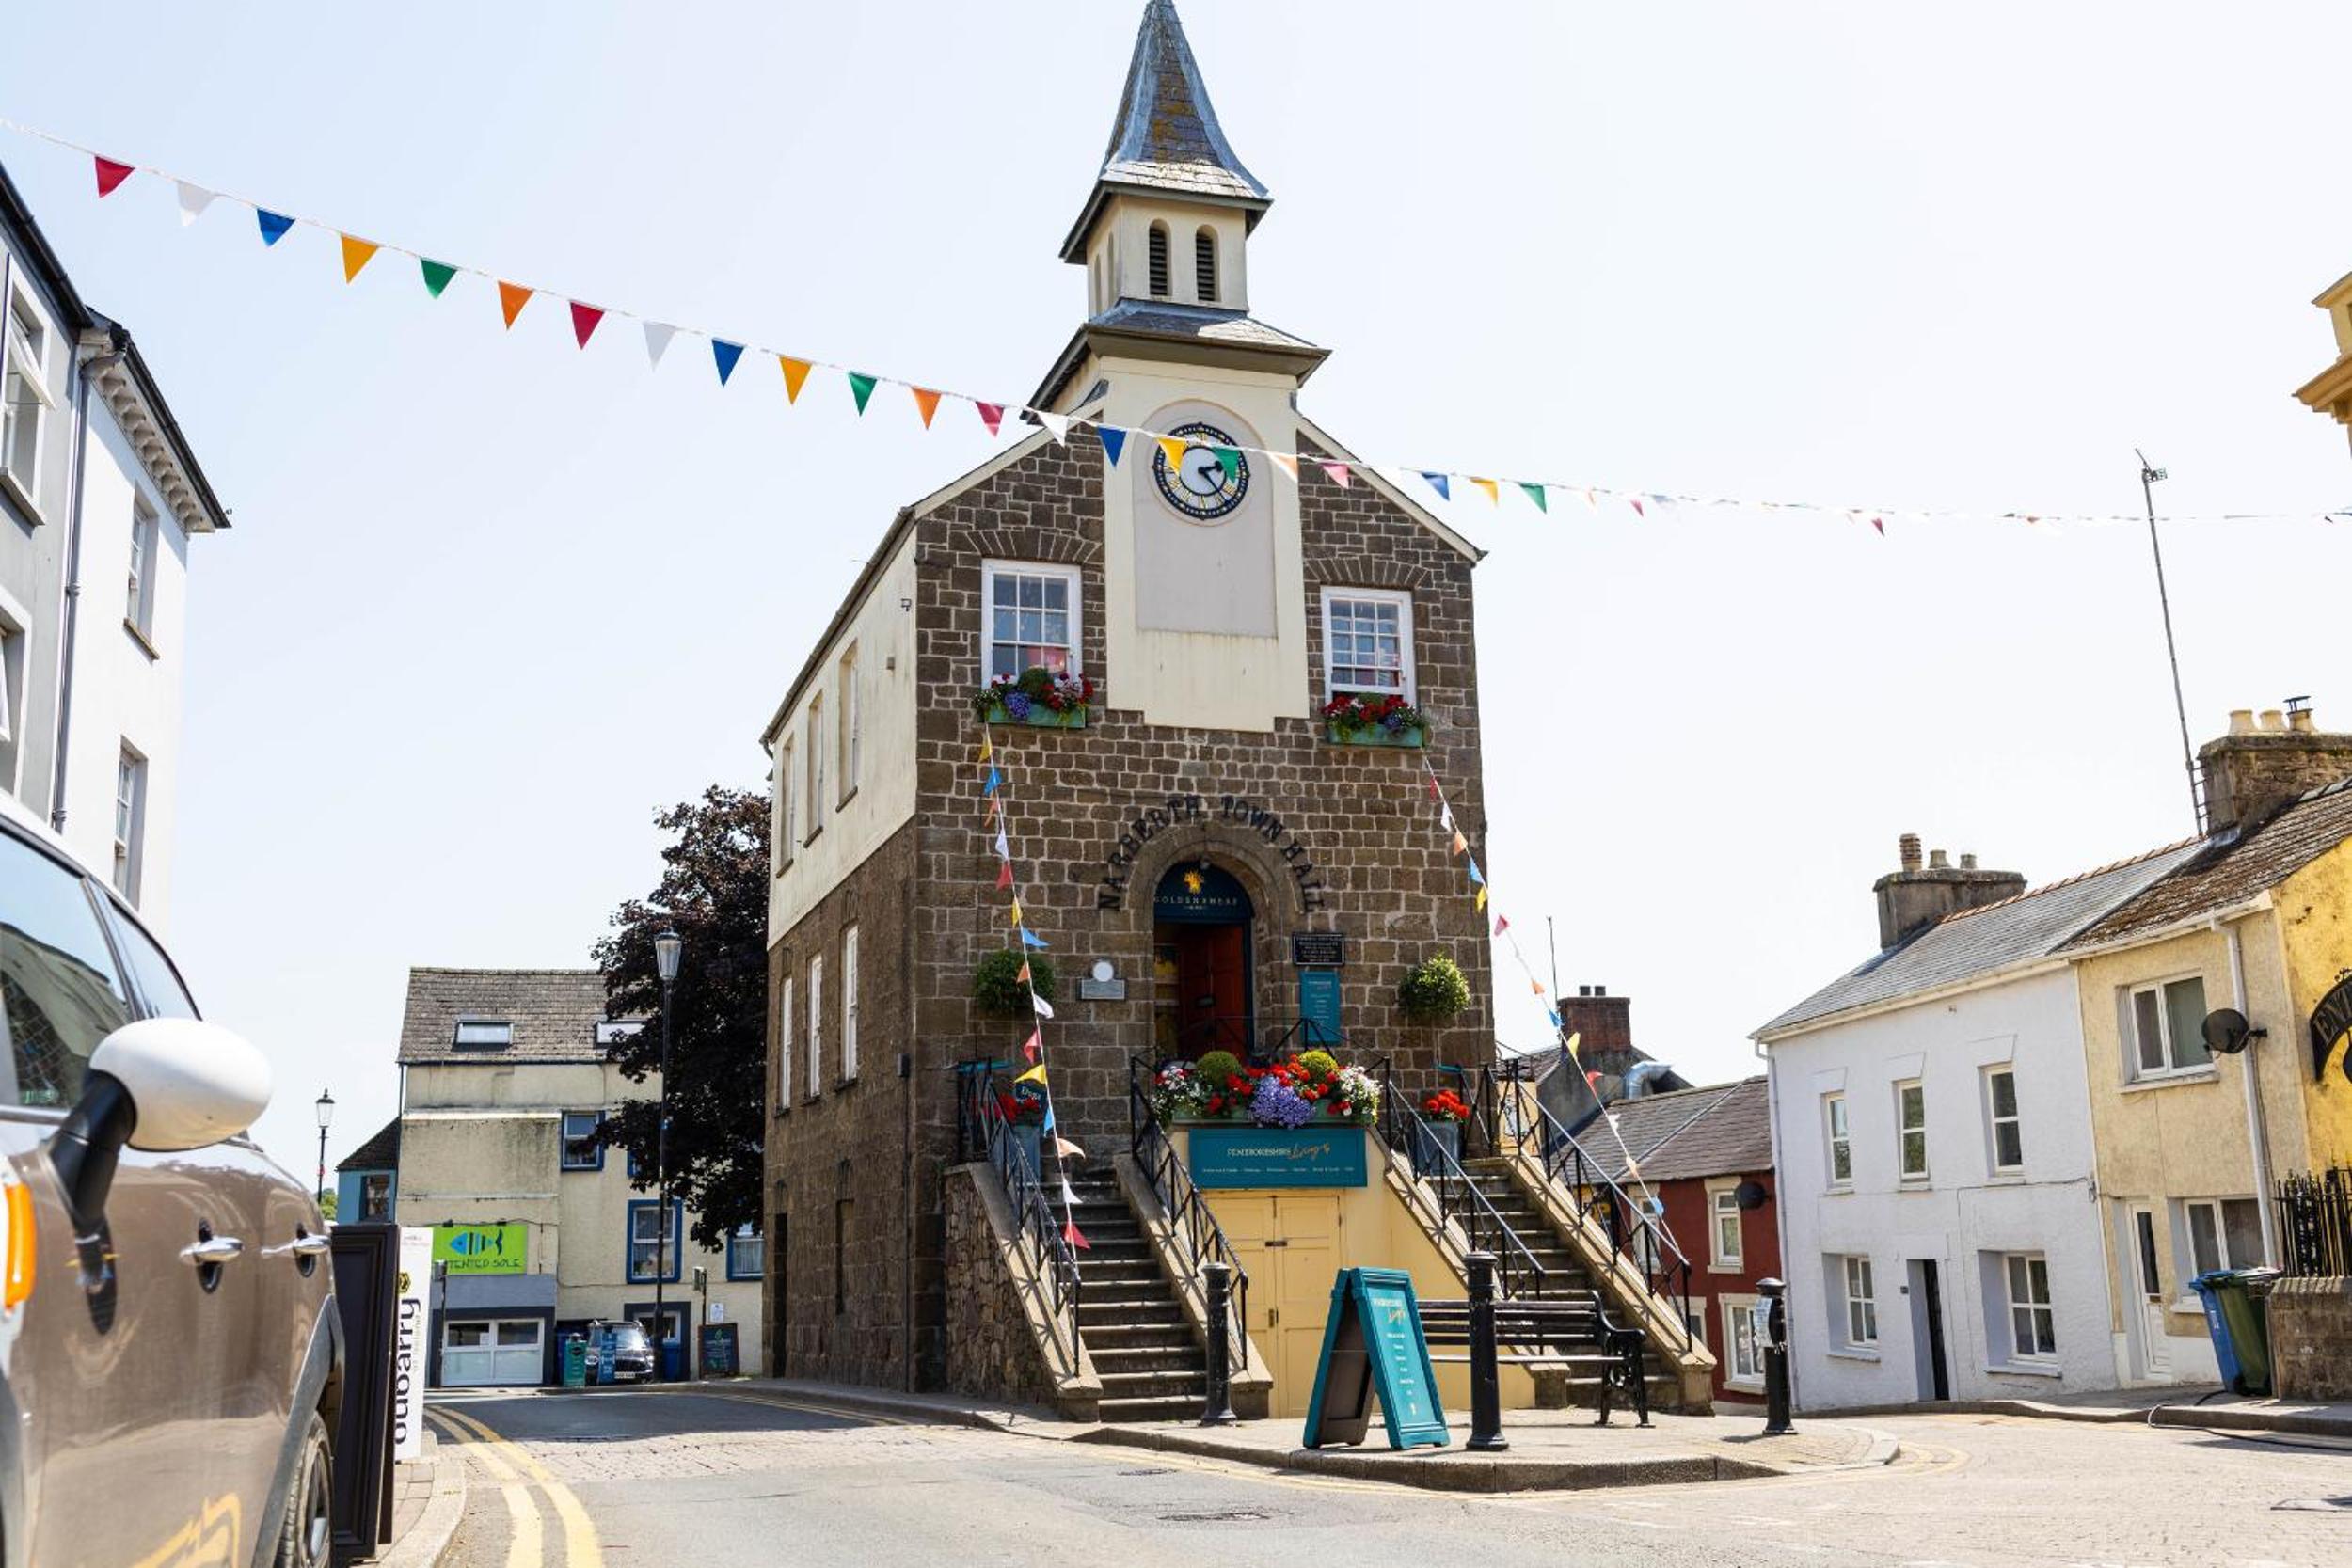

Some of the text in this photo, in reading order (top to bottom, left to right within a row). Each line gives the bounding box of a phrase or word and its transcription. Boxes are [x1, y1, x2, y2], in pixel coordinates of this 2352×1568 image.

[1099, 794, 1325, 912] NARBERTH TOWN HALL
[492, 1259, 520, 1268] SOLE
